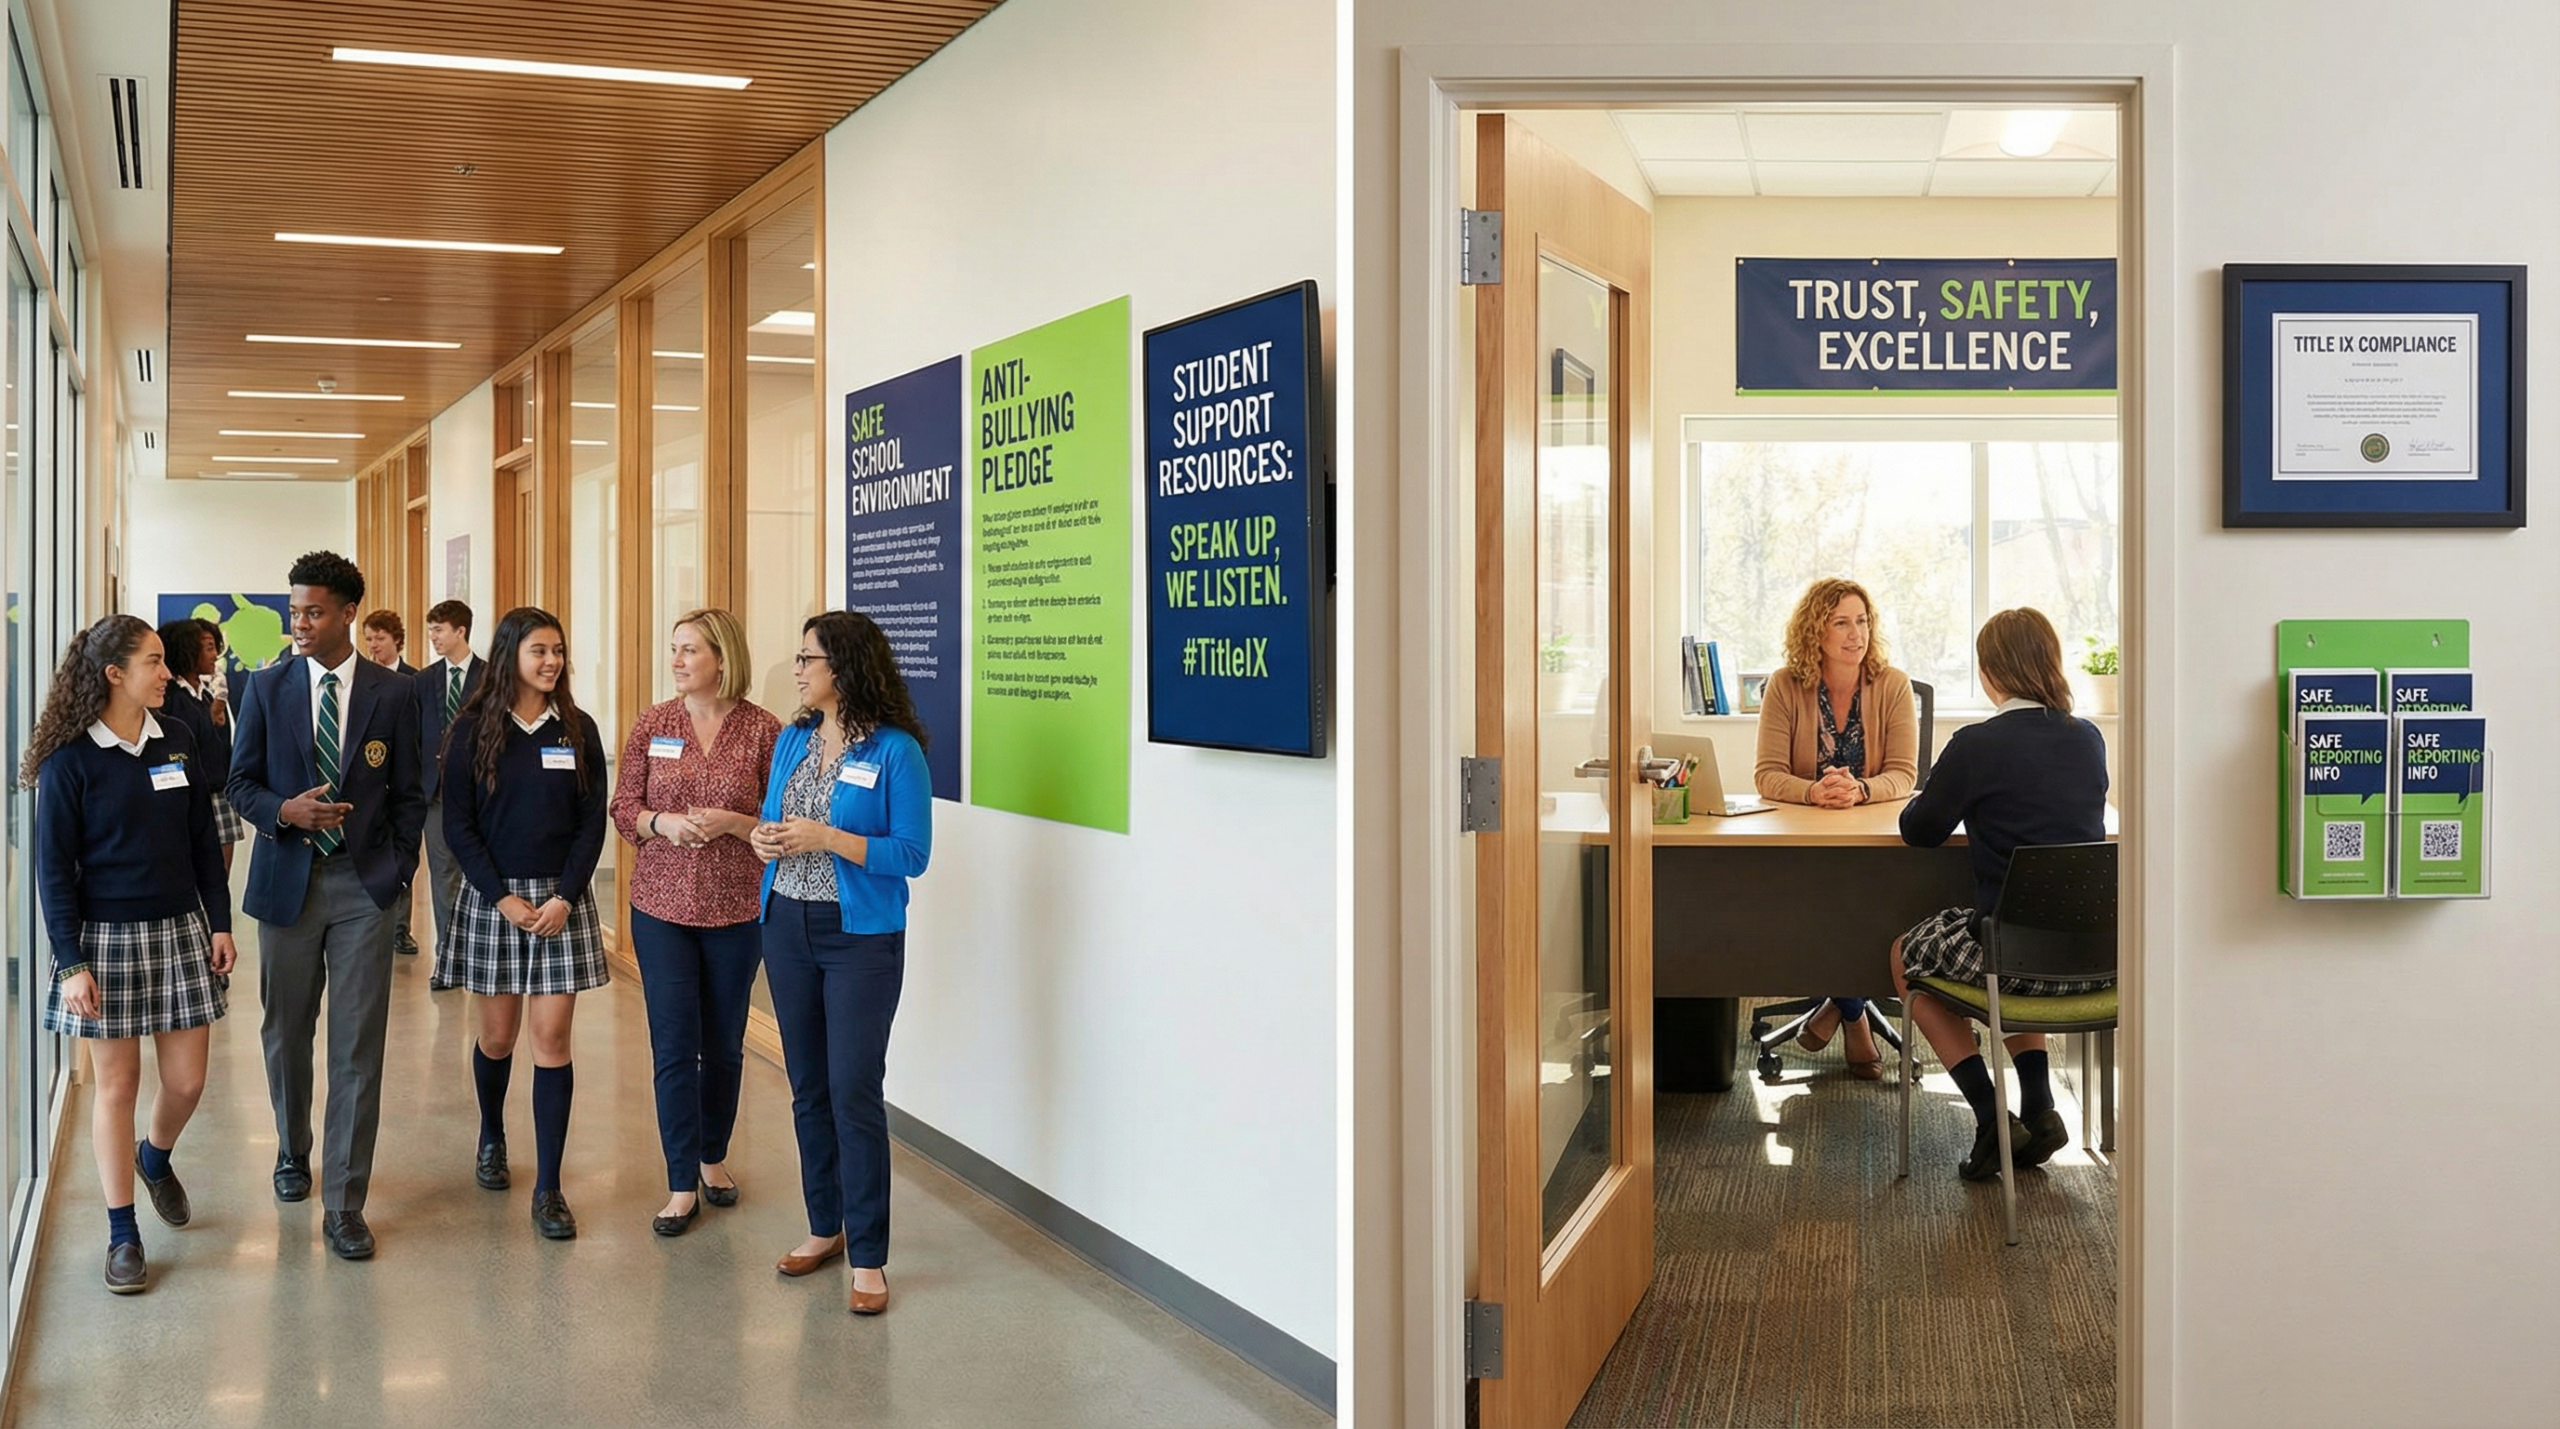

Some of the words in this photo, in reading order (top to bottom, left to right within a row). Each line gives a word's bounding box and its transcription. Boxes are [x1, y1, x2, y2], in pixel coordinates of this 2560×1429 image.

[1788, 279, 1927, 327] TRUST,
[1940, 279, 2099, 328] SAFETY,
[1818, 330, 2072, 371] EXCELLENCE
[2293, 335, 2335, 353] TITLE
[2339, 335, 2354, 353] IX
[2358, 335, 2457, 353] COMPLIANCE
[981, 357, 1031, 406] ANTI-
[1173, 341, 1273, 403] STUDENT
[851, 403, 885, 443] SAFE
[982, 391, 1075, 450] BULLYING
[1173, 391, 1275, 449] SUPPORT
[852, 437, 905, 480] SCHOOL
[982, 443, 1054, 494] PLEDGE
[1159, 439, 1294, 498] RESOURCES:
[852, 464, 953, 516] ENVIRONMENT
[1170, 518, 1240, 562] SPEAK
[1245, 514, 1281, 563] UP,
[1165, 569, 1199, 608] WE
[1203, 564, 1288, 608] LISTEN.
[1182, 637, 1269, 678] #TitleIX
[2300, 688, 2333, 703] SAFE
[2395, 688, 2429, 702] SAFE
[2309, 734, 2343, 749] SAFE
[2309, 750, 2383, 764] REPORTING
[2407, 733, 2441, 748] SAFE
[2407, 749, 2481, 764] REPORTING
[2309, 766, 2340, 781] INFO
[2407, 766, 2438, 780] INFO
